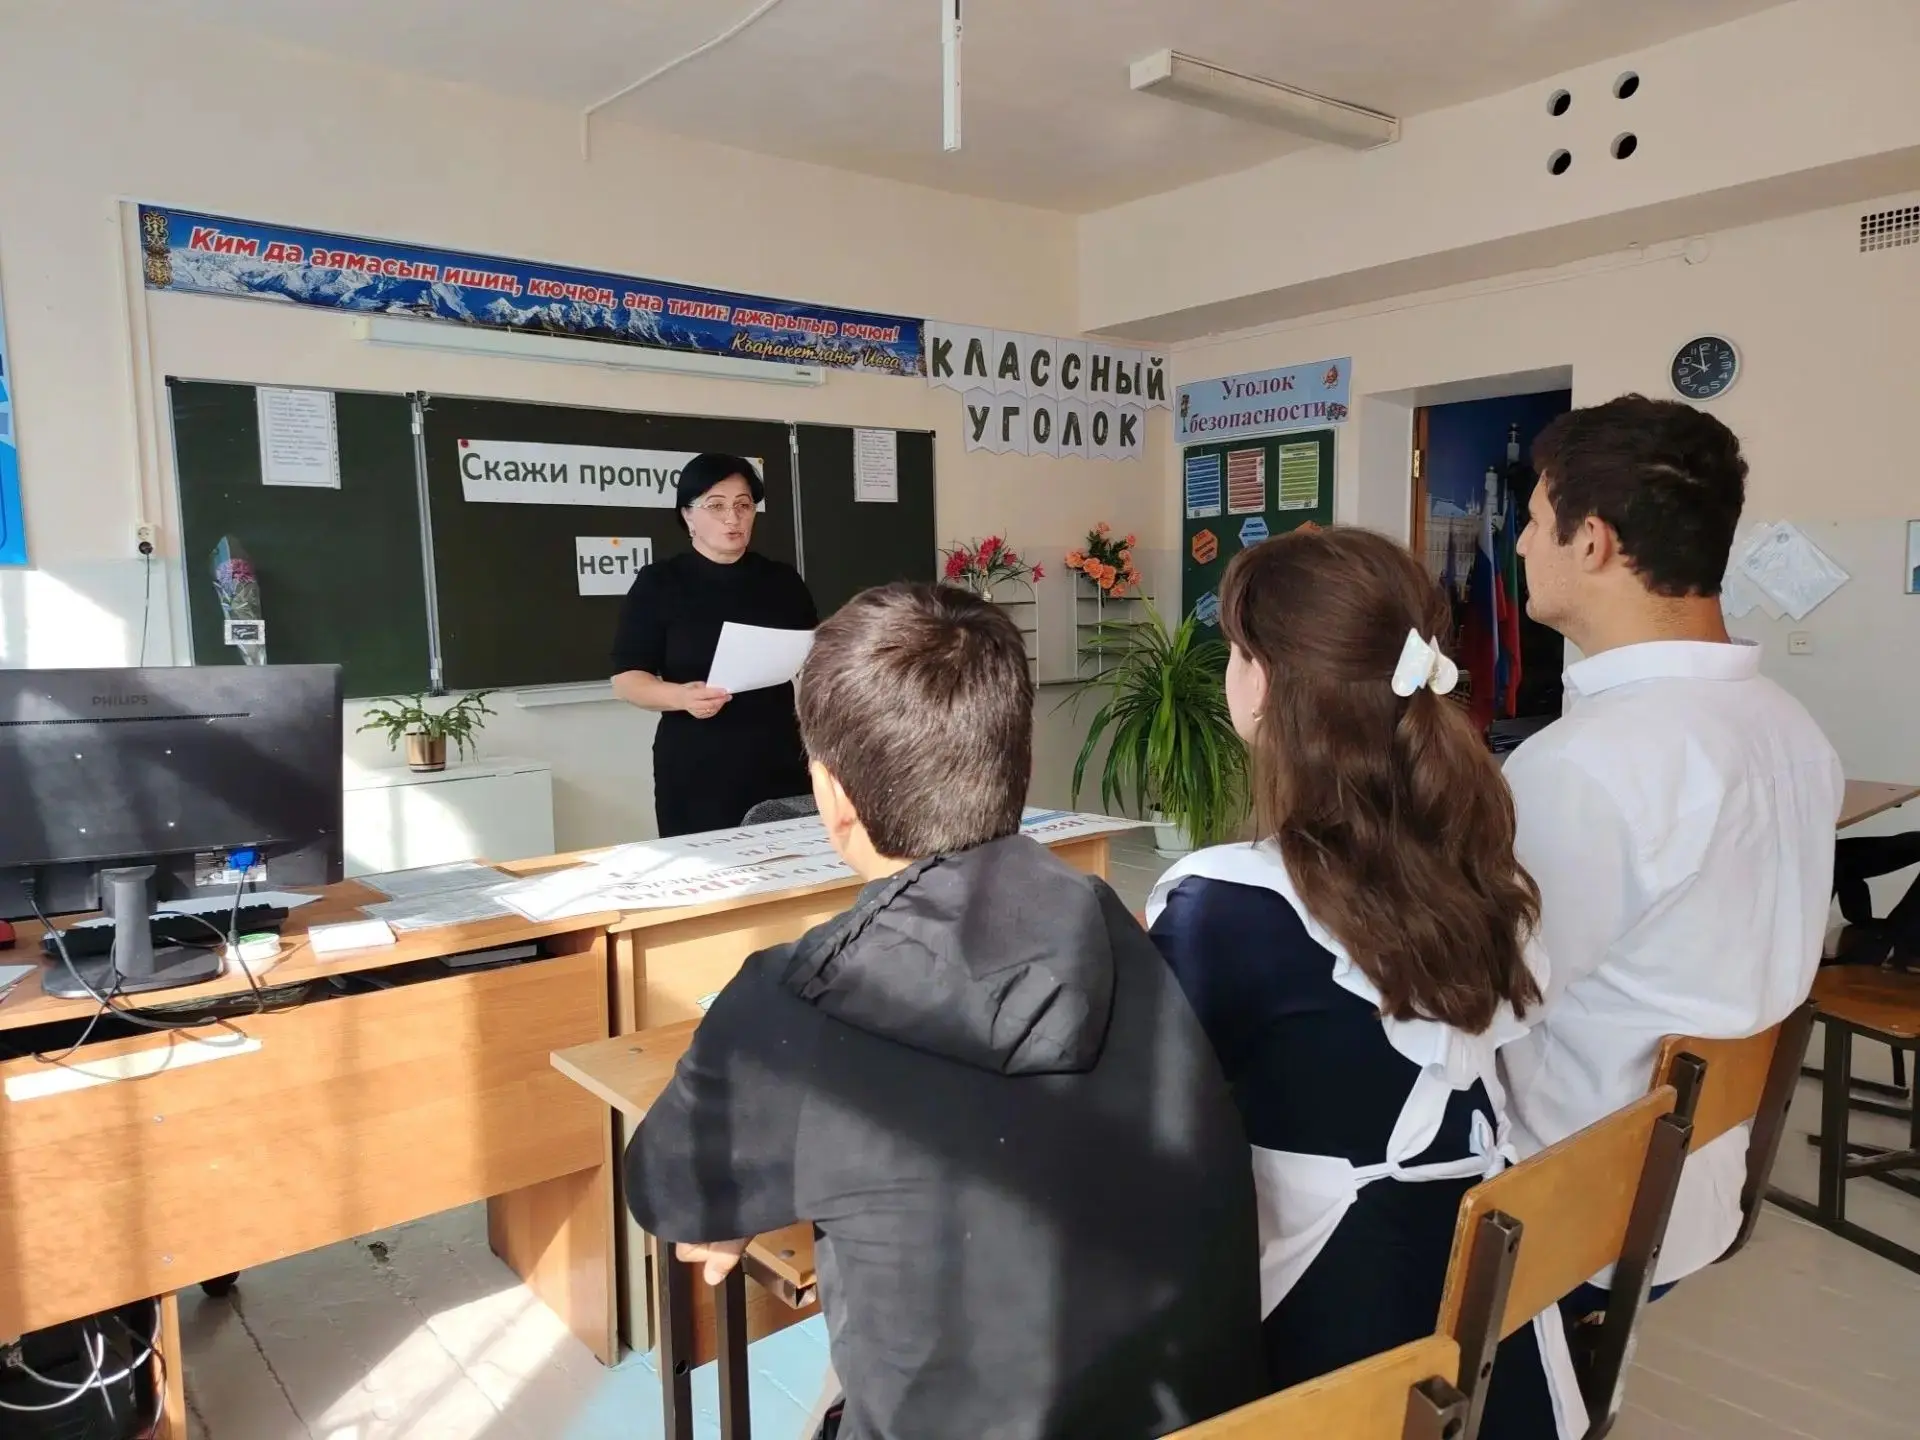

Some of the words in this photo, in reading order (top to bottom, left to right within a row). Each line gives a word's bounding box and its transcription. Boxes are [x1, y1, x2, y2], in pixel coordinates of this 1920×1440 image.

[190, 227, 259, 257] Ким
[263, 241, 303, 264] да
[311, 248, 437, 281] аямасын
[442, 267, 521, 296] ишин,
[528, 277, 618, 309] кючюн,
[623, 291, 662, 312] ана
[732, 307, 837, 336] джарытыр
[841, 321, 899, 343] ючюн!
[862, 346, 901, 368] Исса
[931, 337, 1165, 401] КЛАССНЫЙ
[1221, 373, 1296, 400] Уголок
[967, 404, 1137, 447] УГОЛОК
[1189, 402, 1327, 433] безопасности
[461, 453, 568, 484] Скажи
[579, 463, 683, 494] пропус
[91, 694, 149, 707] PHILIPS
